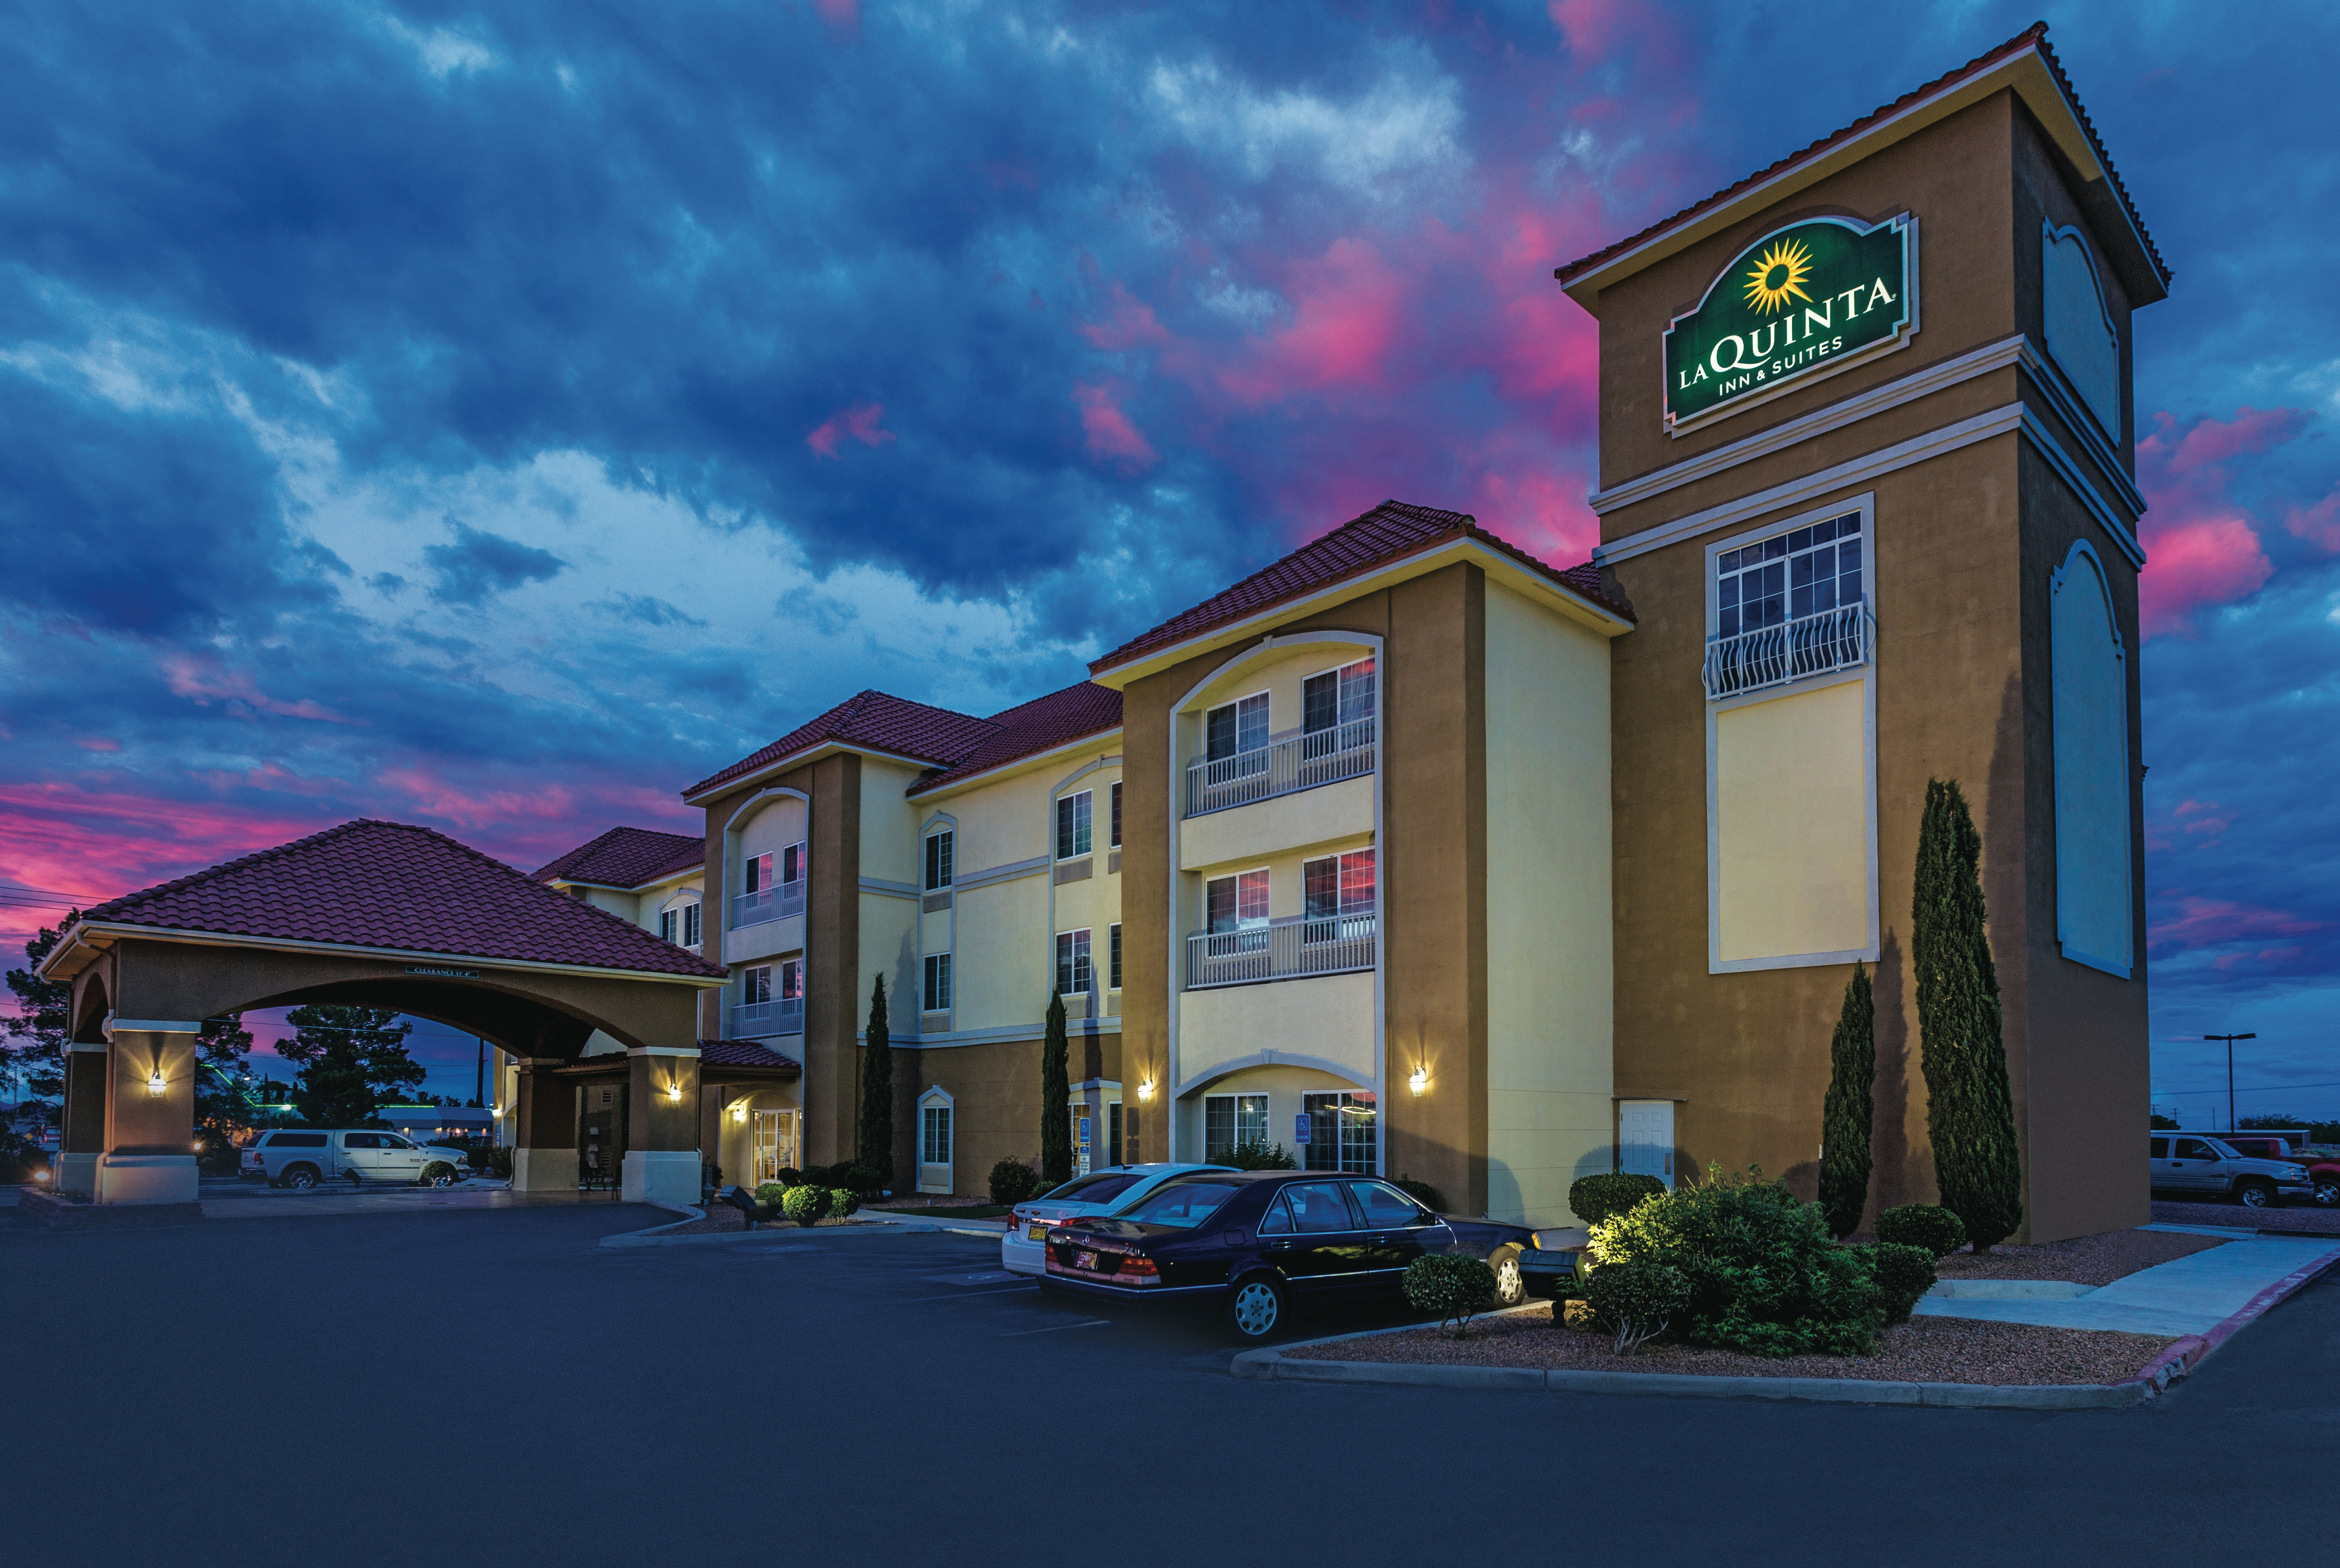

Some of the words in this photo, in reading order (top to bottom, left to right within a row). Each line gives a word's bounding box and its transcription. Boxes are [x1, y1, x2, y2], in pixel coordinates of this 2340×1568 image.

[1679, 363, 1709, 390] LA
[1710, 277, 1896, 373] QUINTA
[1719, 373, 1750, 396] INN
[1756, 369, 1766, 381] &
[1772, 336, 1842, 375] SUITES
